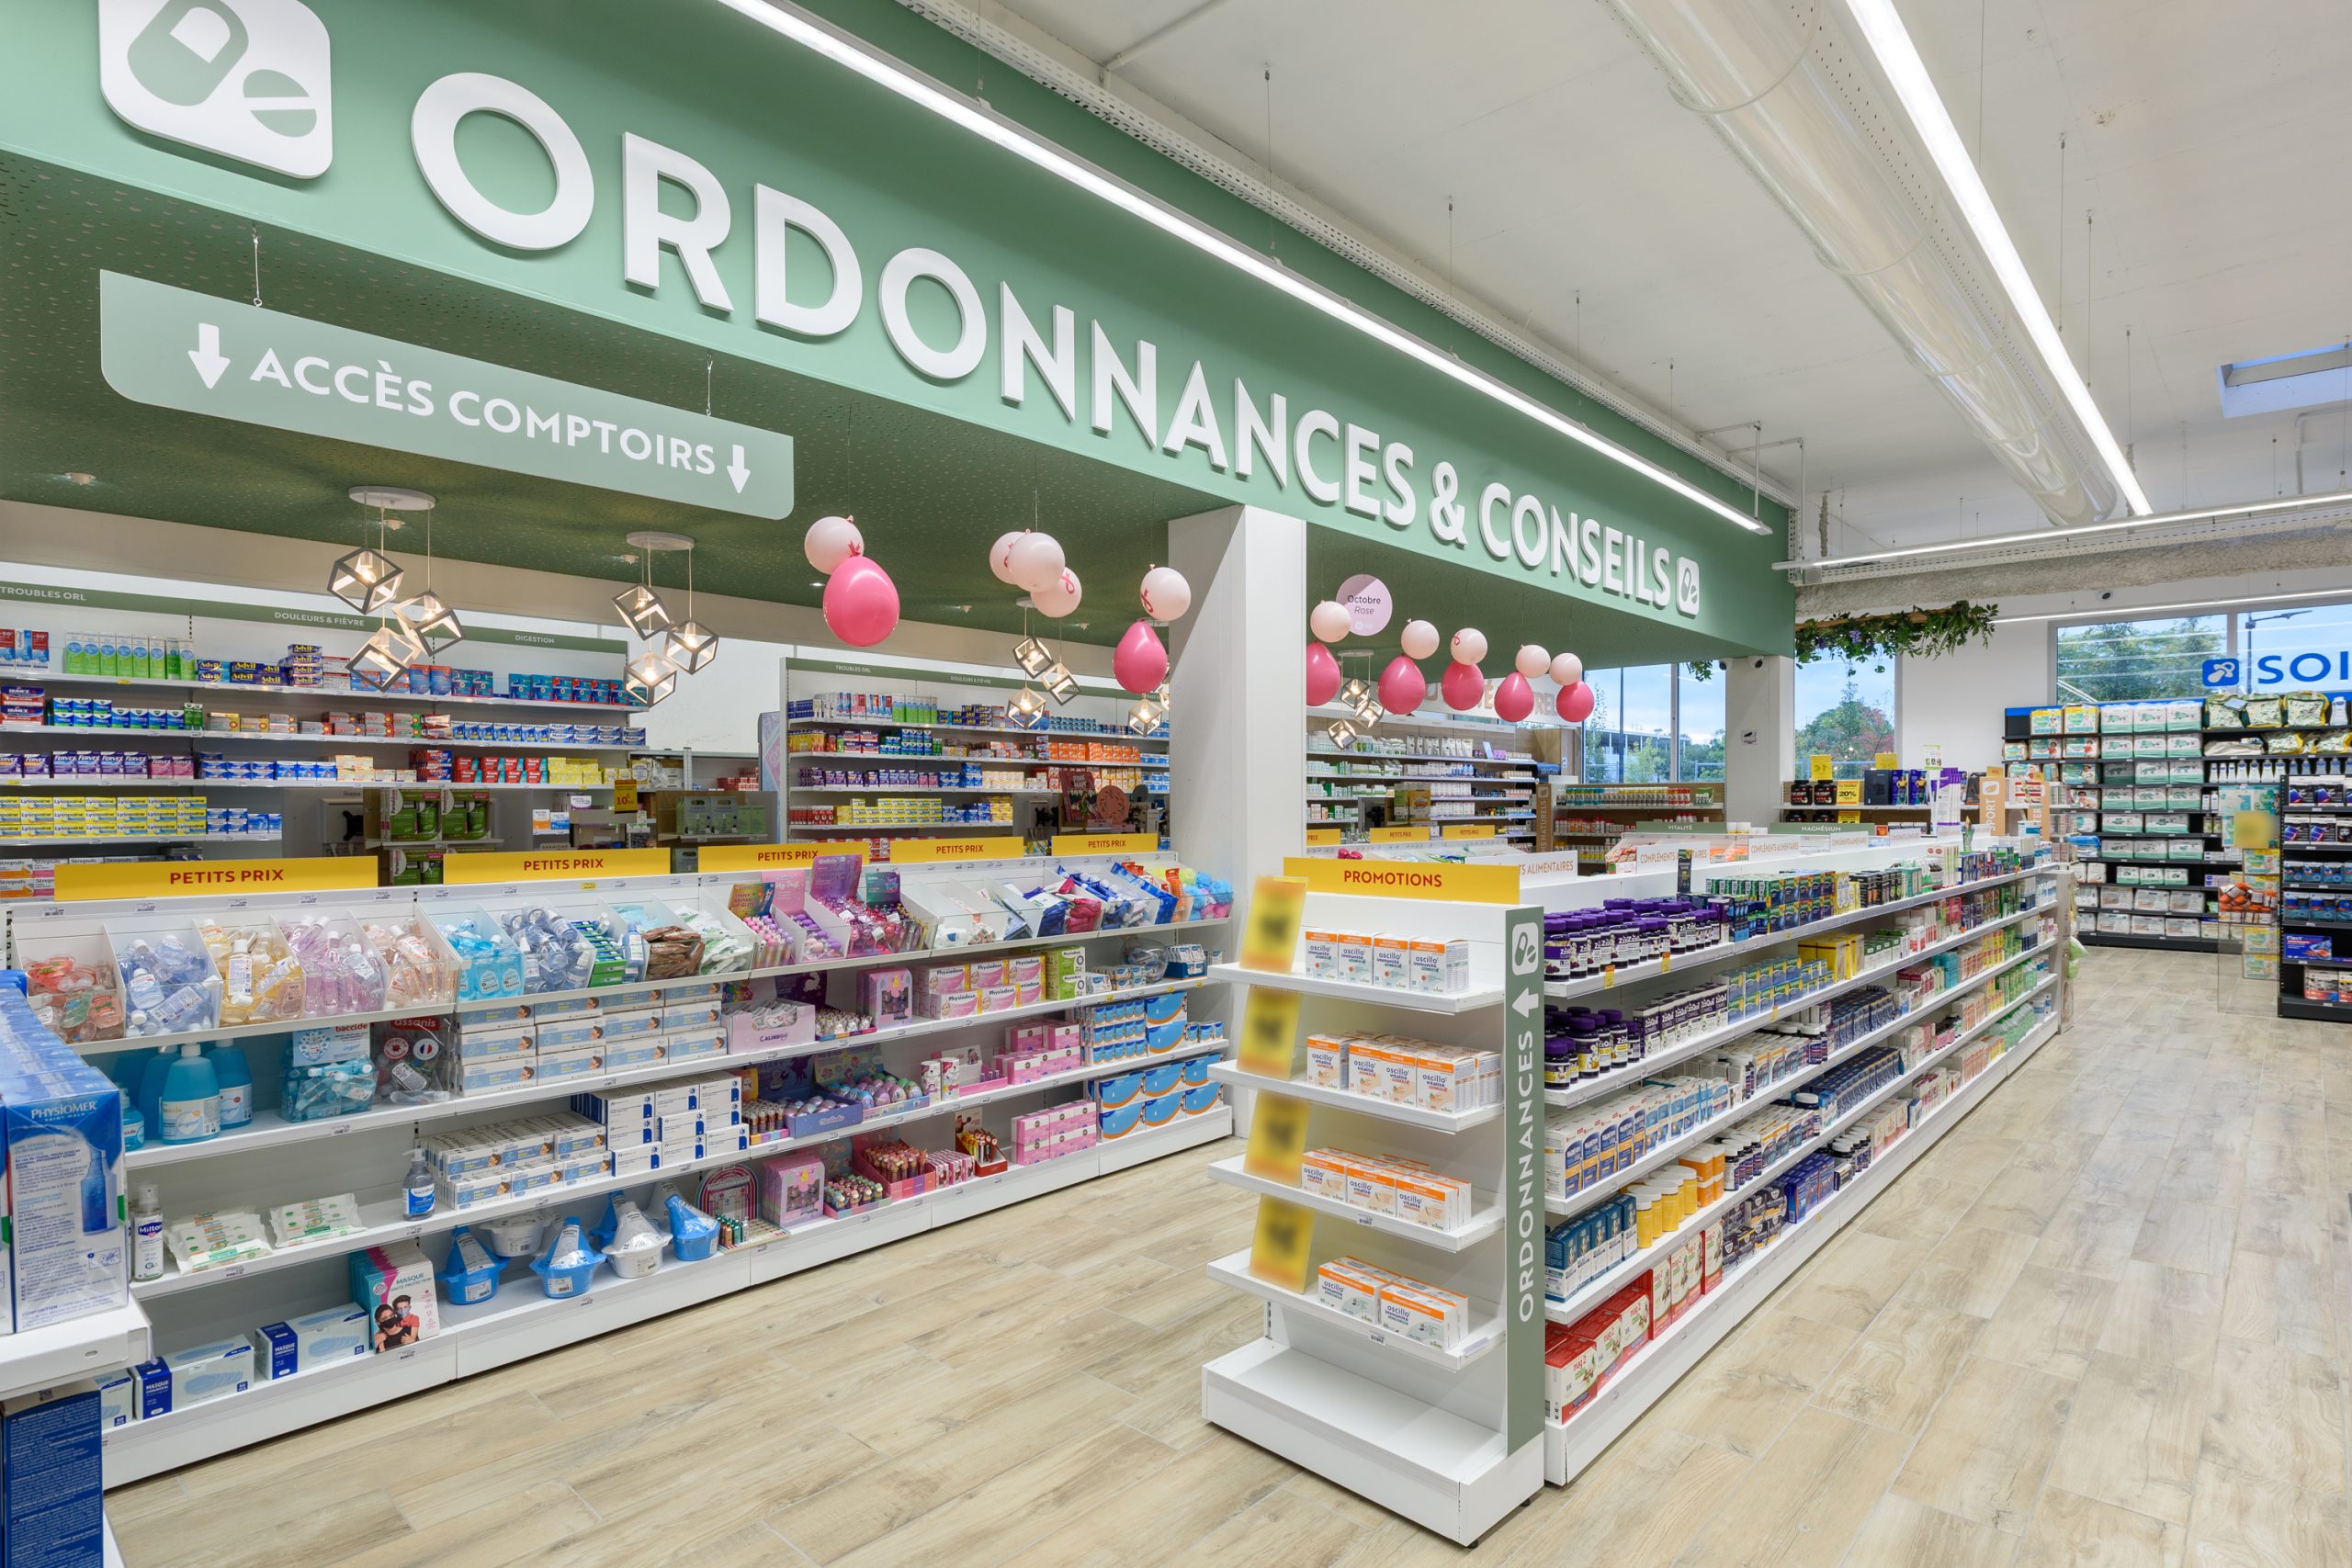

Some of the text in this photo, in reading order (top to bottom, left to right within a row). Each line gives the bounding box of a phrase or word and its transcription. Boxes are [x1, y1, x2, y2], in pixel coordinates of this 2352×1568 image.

[411, 72, 1672, 606] ORDONNANCES & CONSEILS
[249, 347, 715, 476] ACCÈS COMPTOIRS
[1, 587, 85, 601] TROUBLES ORL
[1348, 595, 1381, 604] Octobre
[1354, 606, 1374, 615] Rose
[275, 612, 324, 623] DOULEURS
[334, 616, 365, 626] FIÈVRE
[515, 635, 554, 644] DIGESTION
[936, 844, 984, 854] PETITS PRIX
[1088, 840, 1109, 848] PETITS
[758, 852, 792, 862] PETITS
[795, 850, 819, 861] PRIX
[1641, 851, 1675, 863] COMPLÉMENTS
[524, 858, 604, 871] PETITS PRIX
[1527, 860, 1574, 874] ALIMENTAIRES
[170, 869, 284, 885] PETITS PRIX
[1344, 870, 1442, 887] PROMOTIONS
[1416, 955, 1437, 964] oscillo
[335, 1022, 368, 1032] baccide
[1312, 1053, 1332, 1061] oscillo
[1354, 1060, 1374, 1068] oscillo
[1386, 1066, 1408, 1076] oscillo
[1422, 1074, 1446, 1083] oscillo
[31, 1101, 96, 1119] PHYSIOMER
[1304, 1167, 1323, 1177] oscillo
[1518, 1030, 1533, 1323] ORDONNANCES
[1350, 1180, 1371, 1190] oscillo
[1399, 1193, 1421, 1203] oscillo
[396, 1273, 424, 1285] MASQUE
[1324, 1280, 1343, 1292] oscillo
[1386, 1305, 1409, 1317] oscillo
[275, 1343, 295, 1352] MASQUE
[146, 1380, 169, 1391] MASQUE
